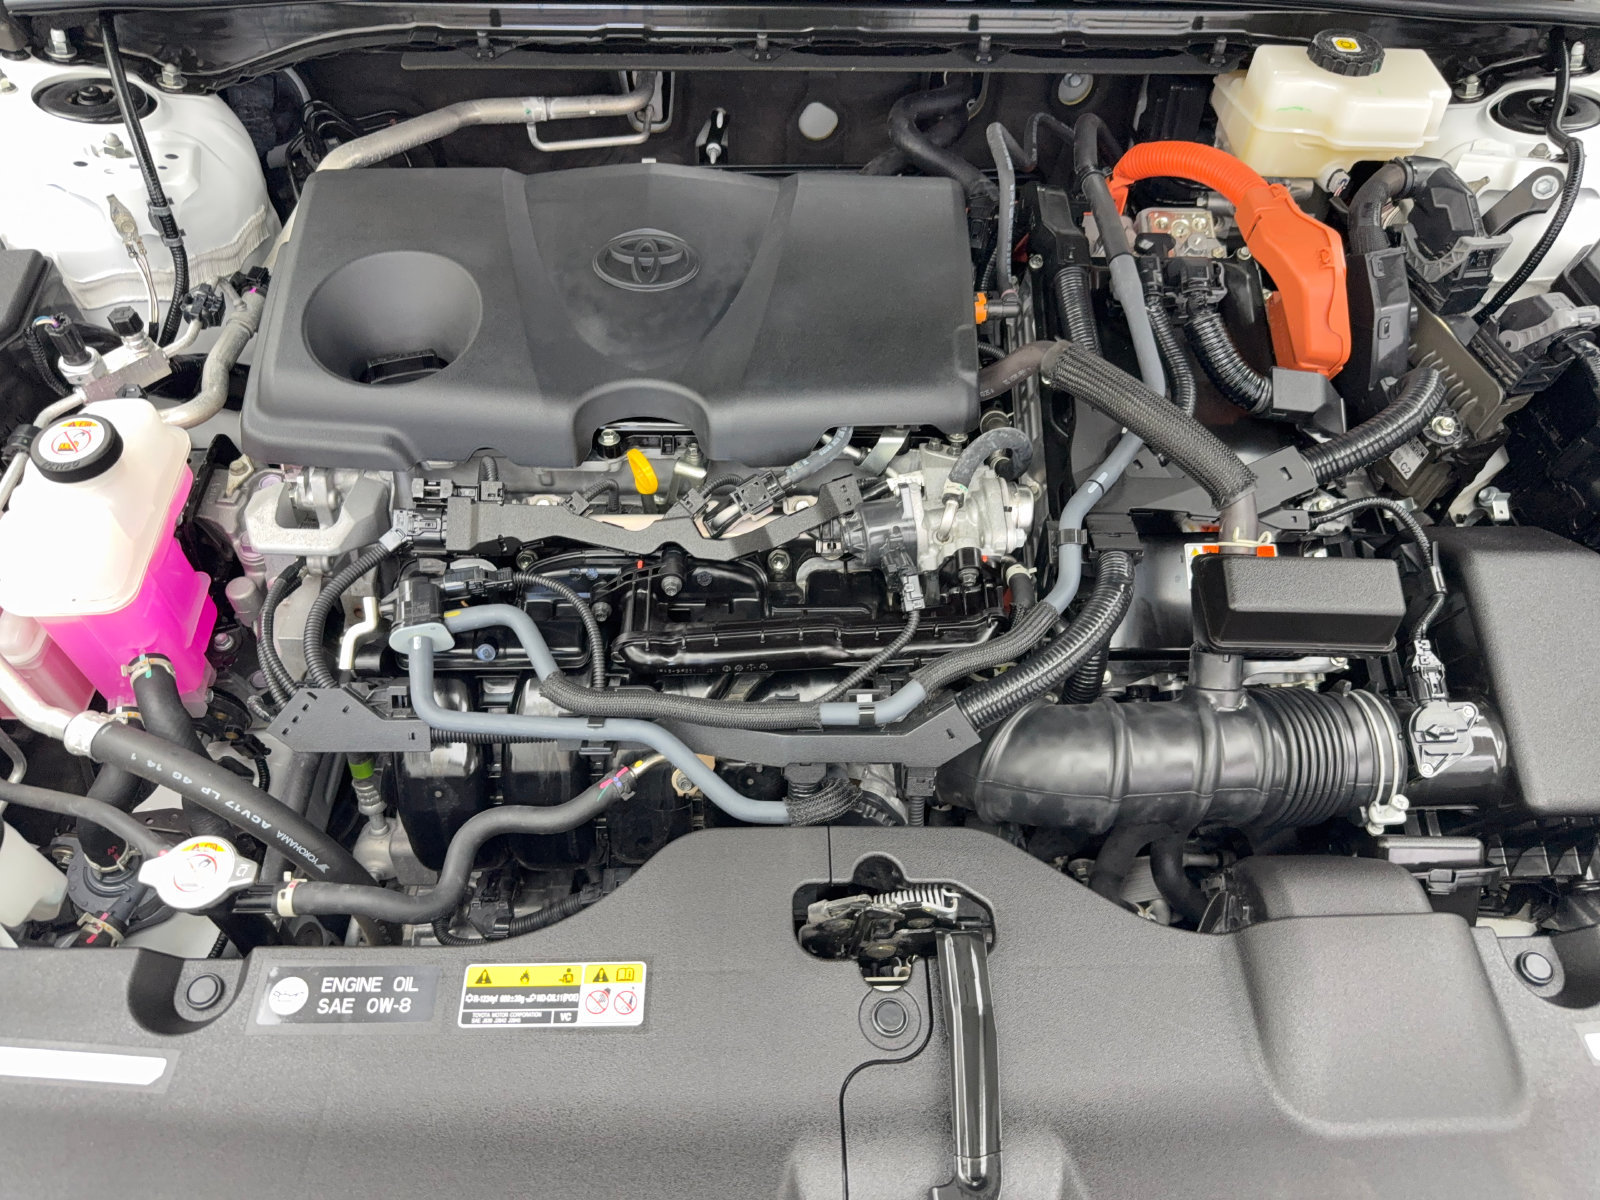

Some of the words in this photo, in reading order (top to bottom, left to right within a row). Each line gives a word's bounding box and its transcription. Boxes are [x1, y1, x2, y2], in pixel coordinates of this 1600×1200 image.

[1400, 462, 1412, 476] C2
[200, 786, 221, 801] LP
[224, 801, 272, 830] ACV17
[275, 830, 318, 866] YOKOHAMA
[320, 976, 384, 993] ENGINE
[393, 976, 419, 992] OIL
[316, 998, 355, 1014] SAE
[366, 998, 412, 1014] 0W-8
[560, 1012, 572, 1022] VC
